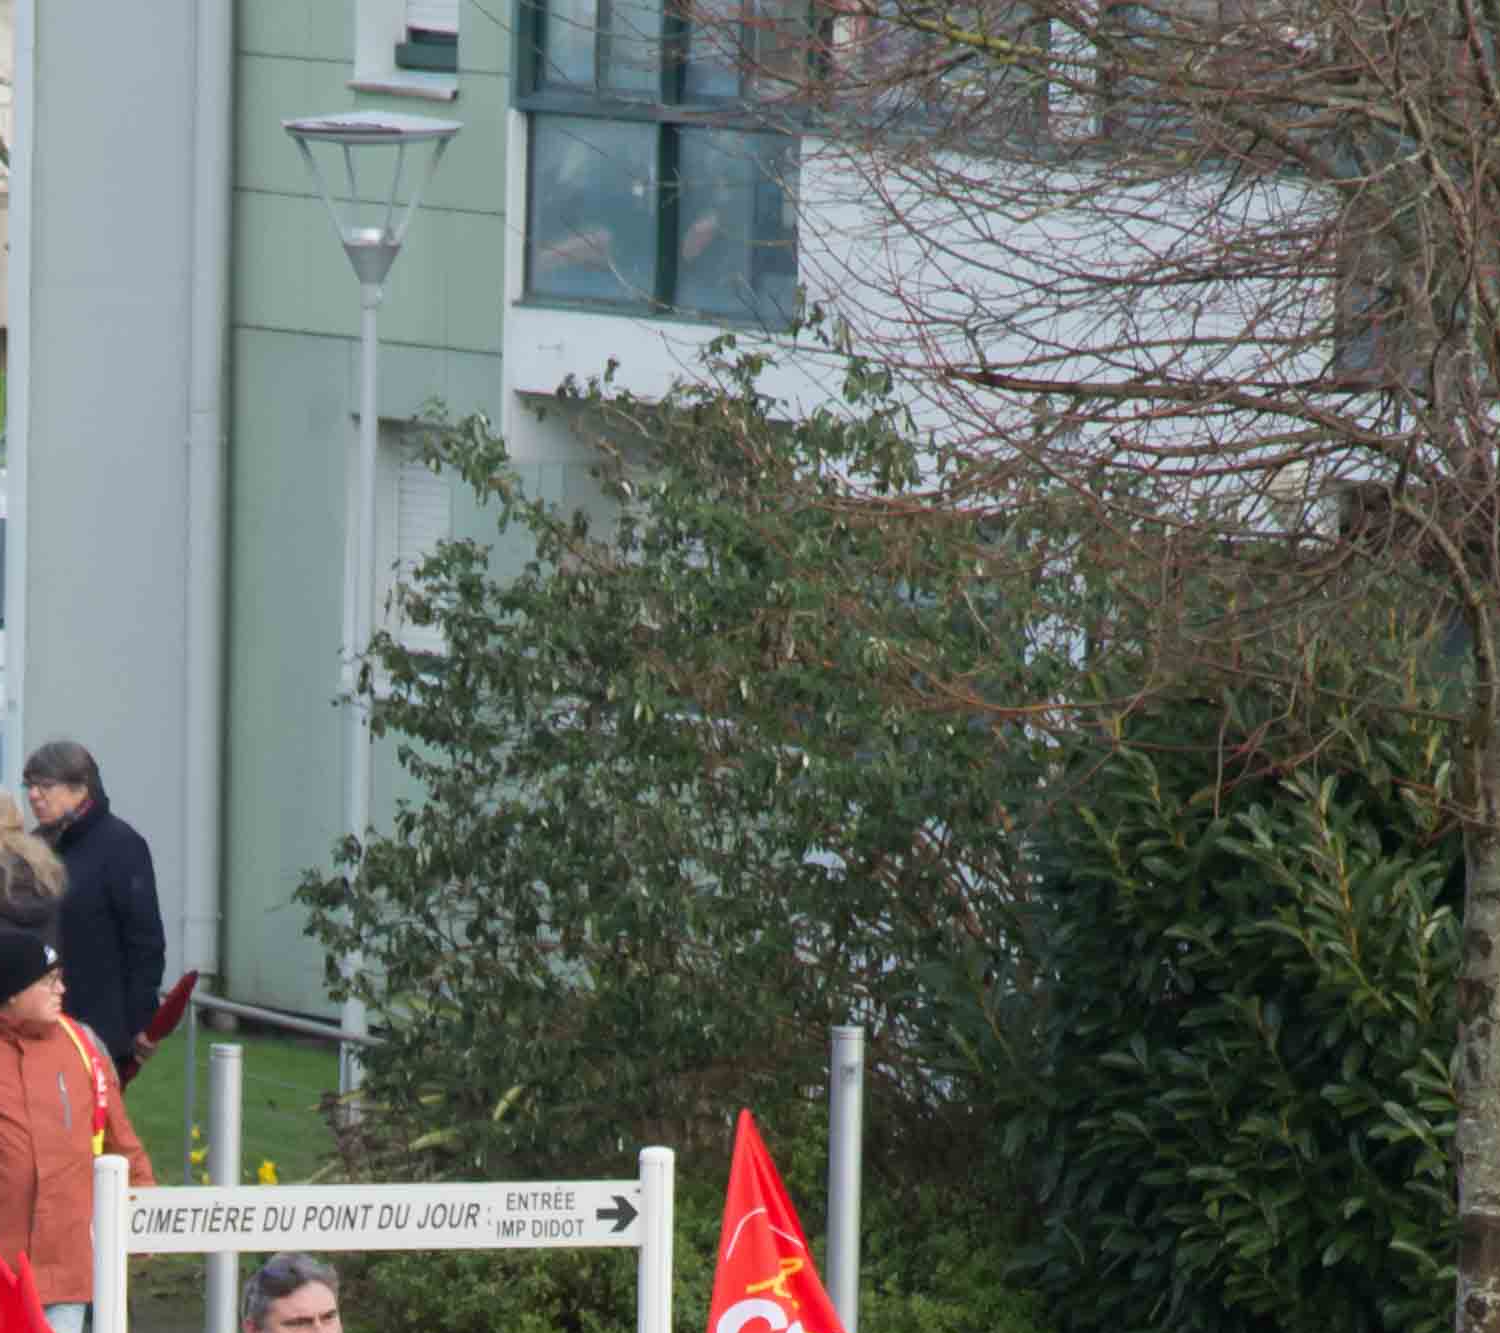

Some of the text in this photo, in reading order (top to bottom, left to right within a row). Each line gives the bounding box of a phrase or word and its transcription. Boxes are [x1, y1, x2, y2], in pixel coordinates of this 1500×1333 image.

[506, 1185, 576, 1211] ENTRÉE
[130, 1201, 256, 1234] CIMETIÈRE
[262, 1205, 297, 1233] DU
[302, 1204, 374, 1232] POINT
[377, 1203, 410, 1230] DU
[496, 1218, 585, 1239] IMP DIDOT
